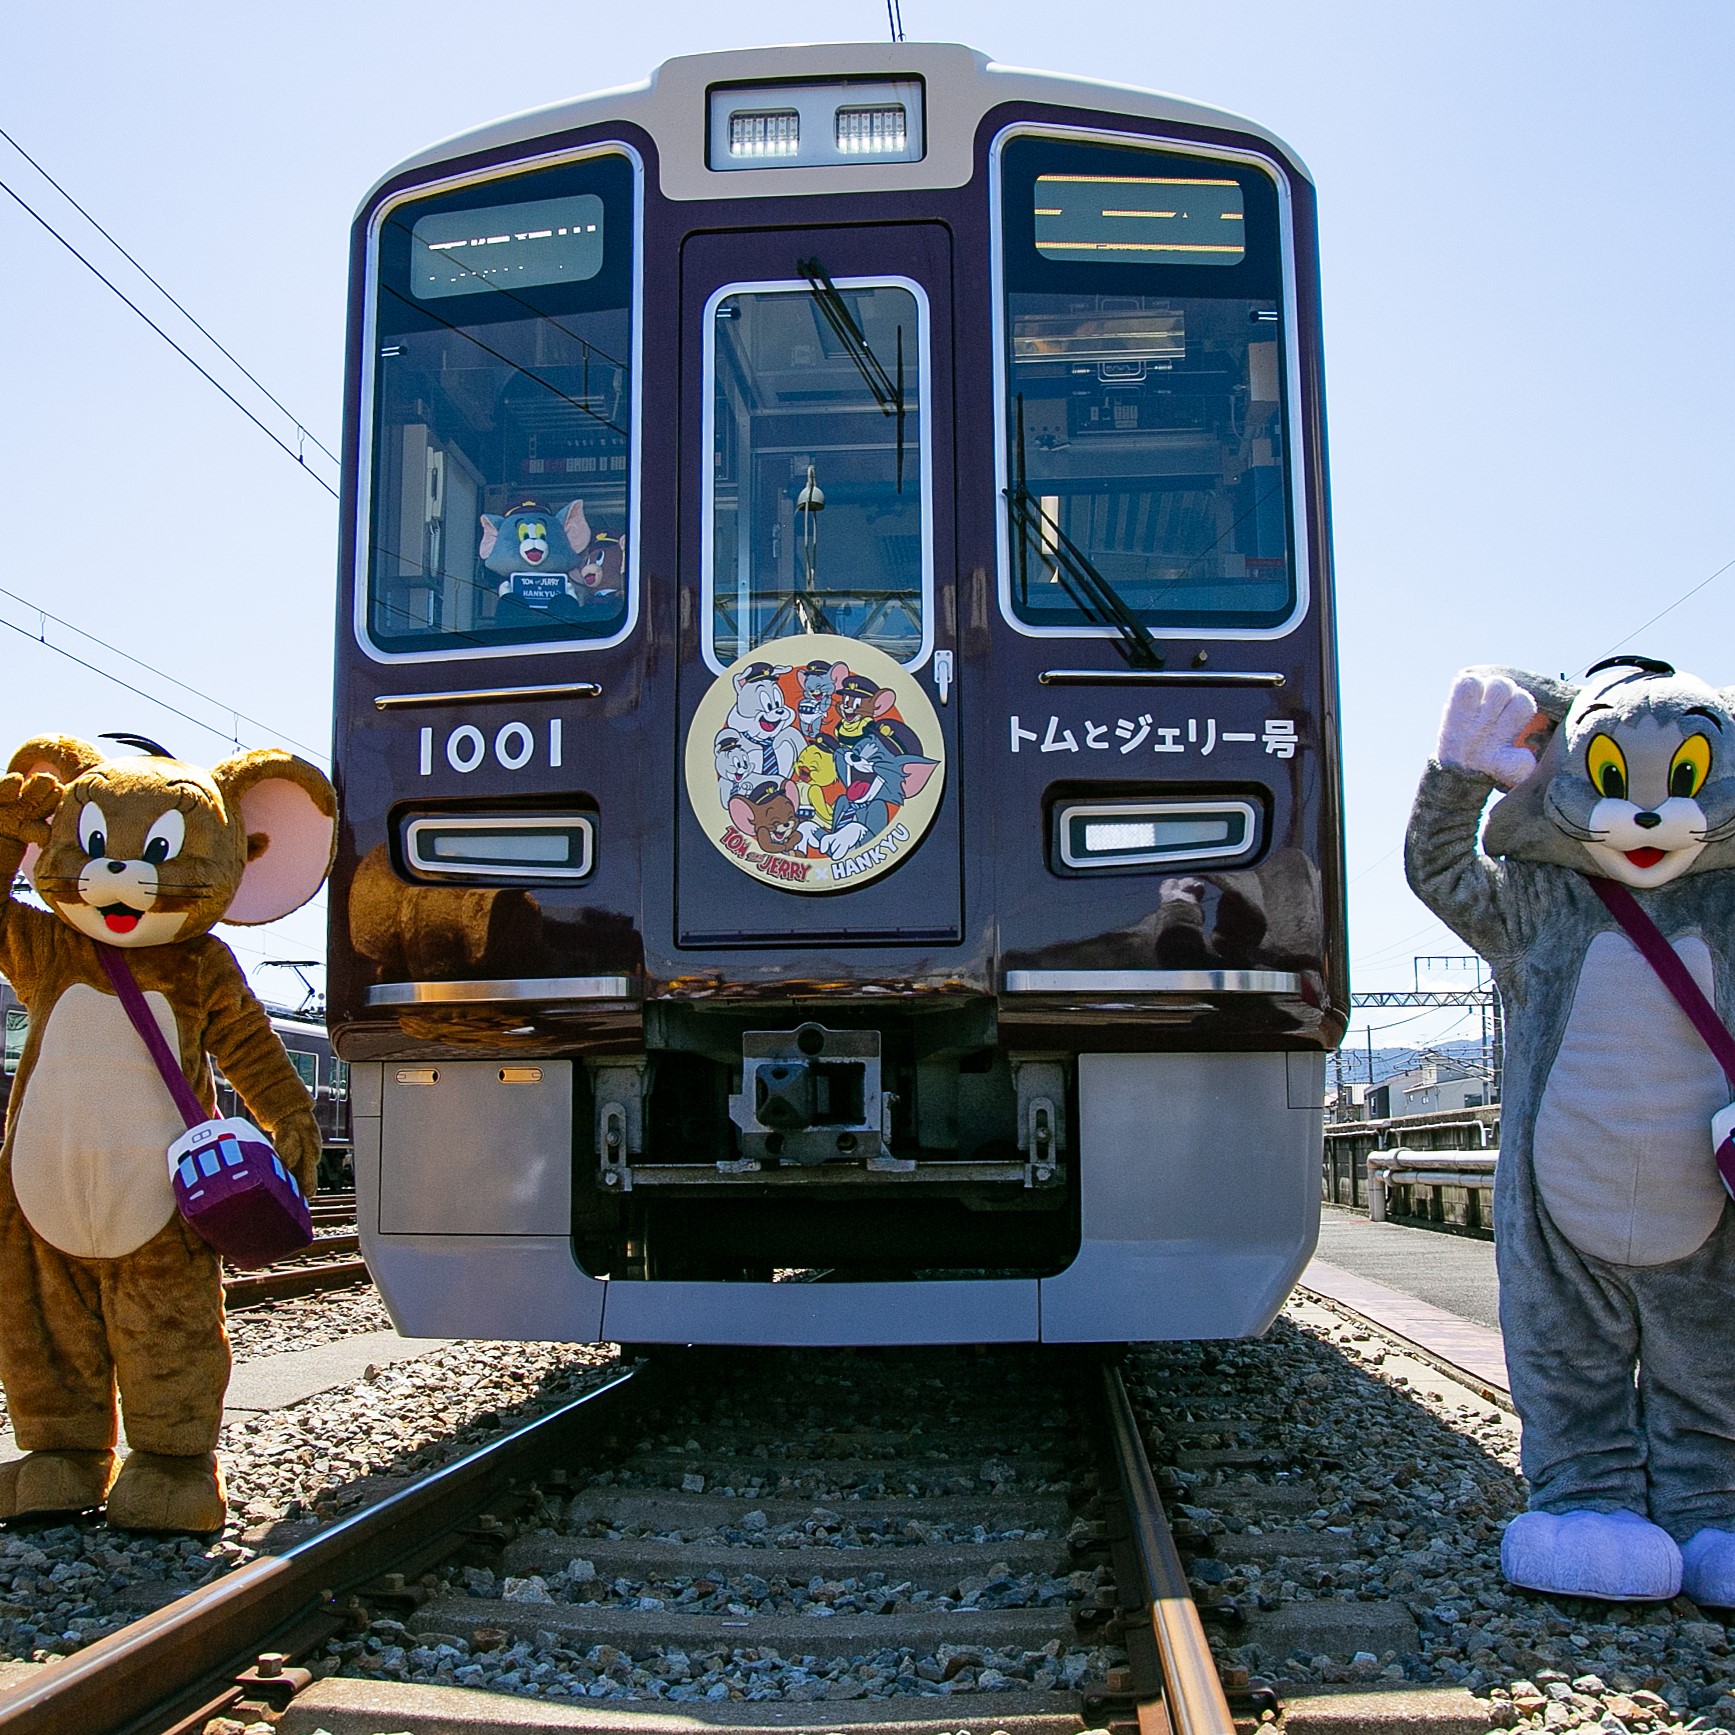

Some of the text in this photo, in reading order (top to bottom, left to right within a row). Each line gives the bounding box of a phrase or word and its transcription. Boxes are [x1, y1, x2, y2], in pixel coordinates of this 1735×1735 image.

[420, 718, 562, 776] 1001
[1010, 713, 1298, 758] トムとジェリー号
[720, 826, 751, 859] TOM
[757, 855, 812, 882] JERRY
[831, 823, 910, 880] HANKYU
